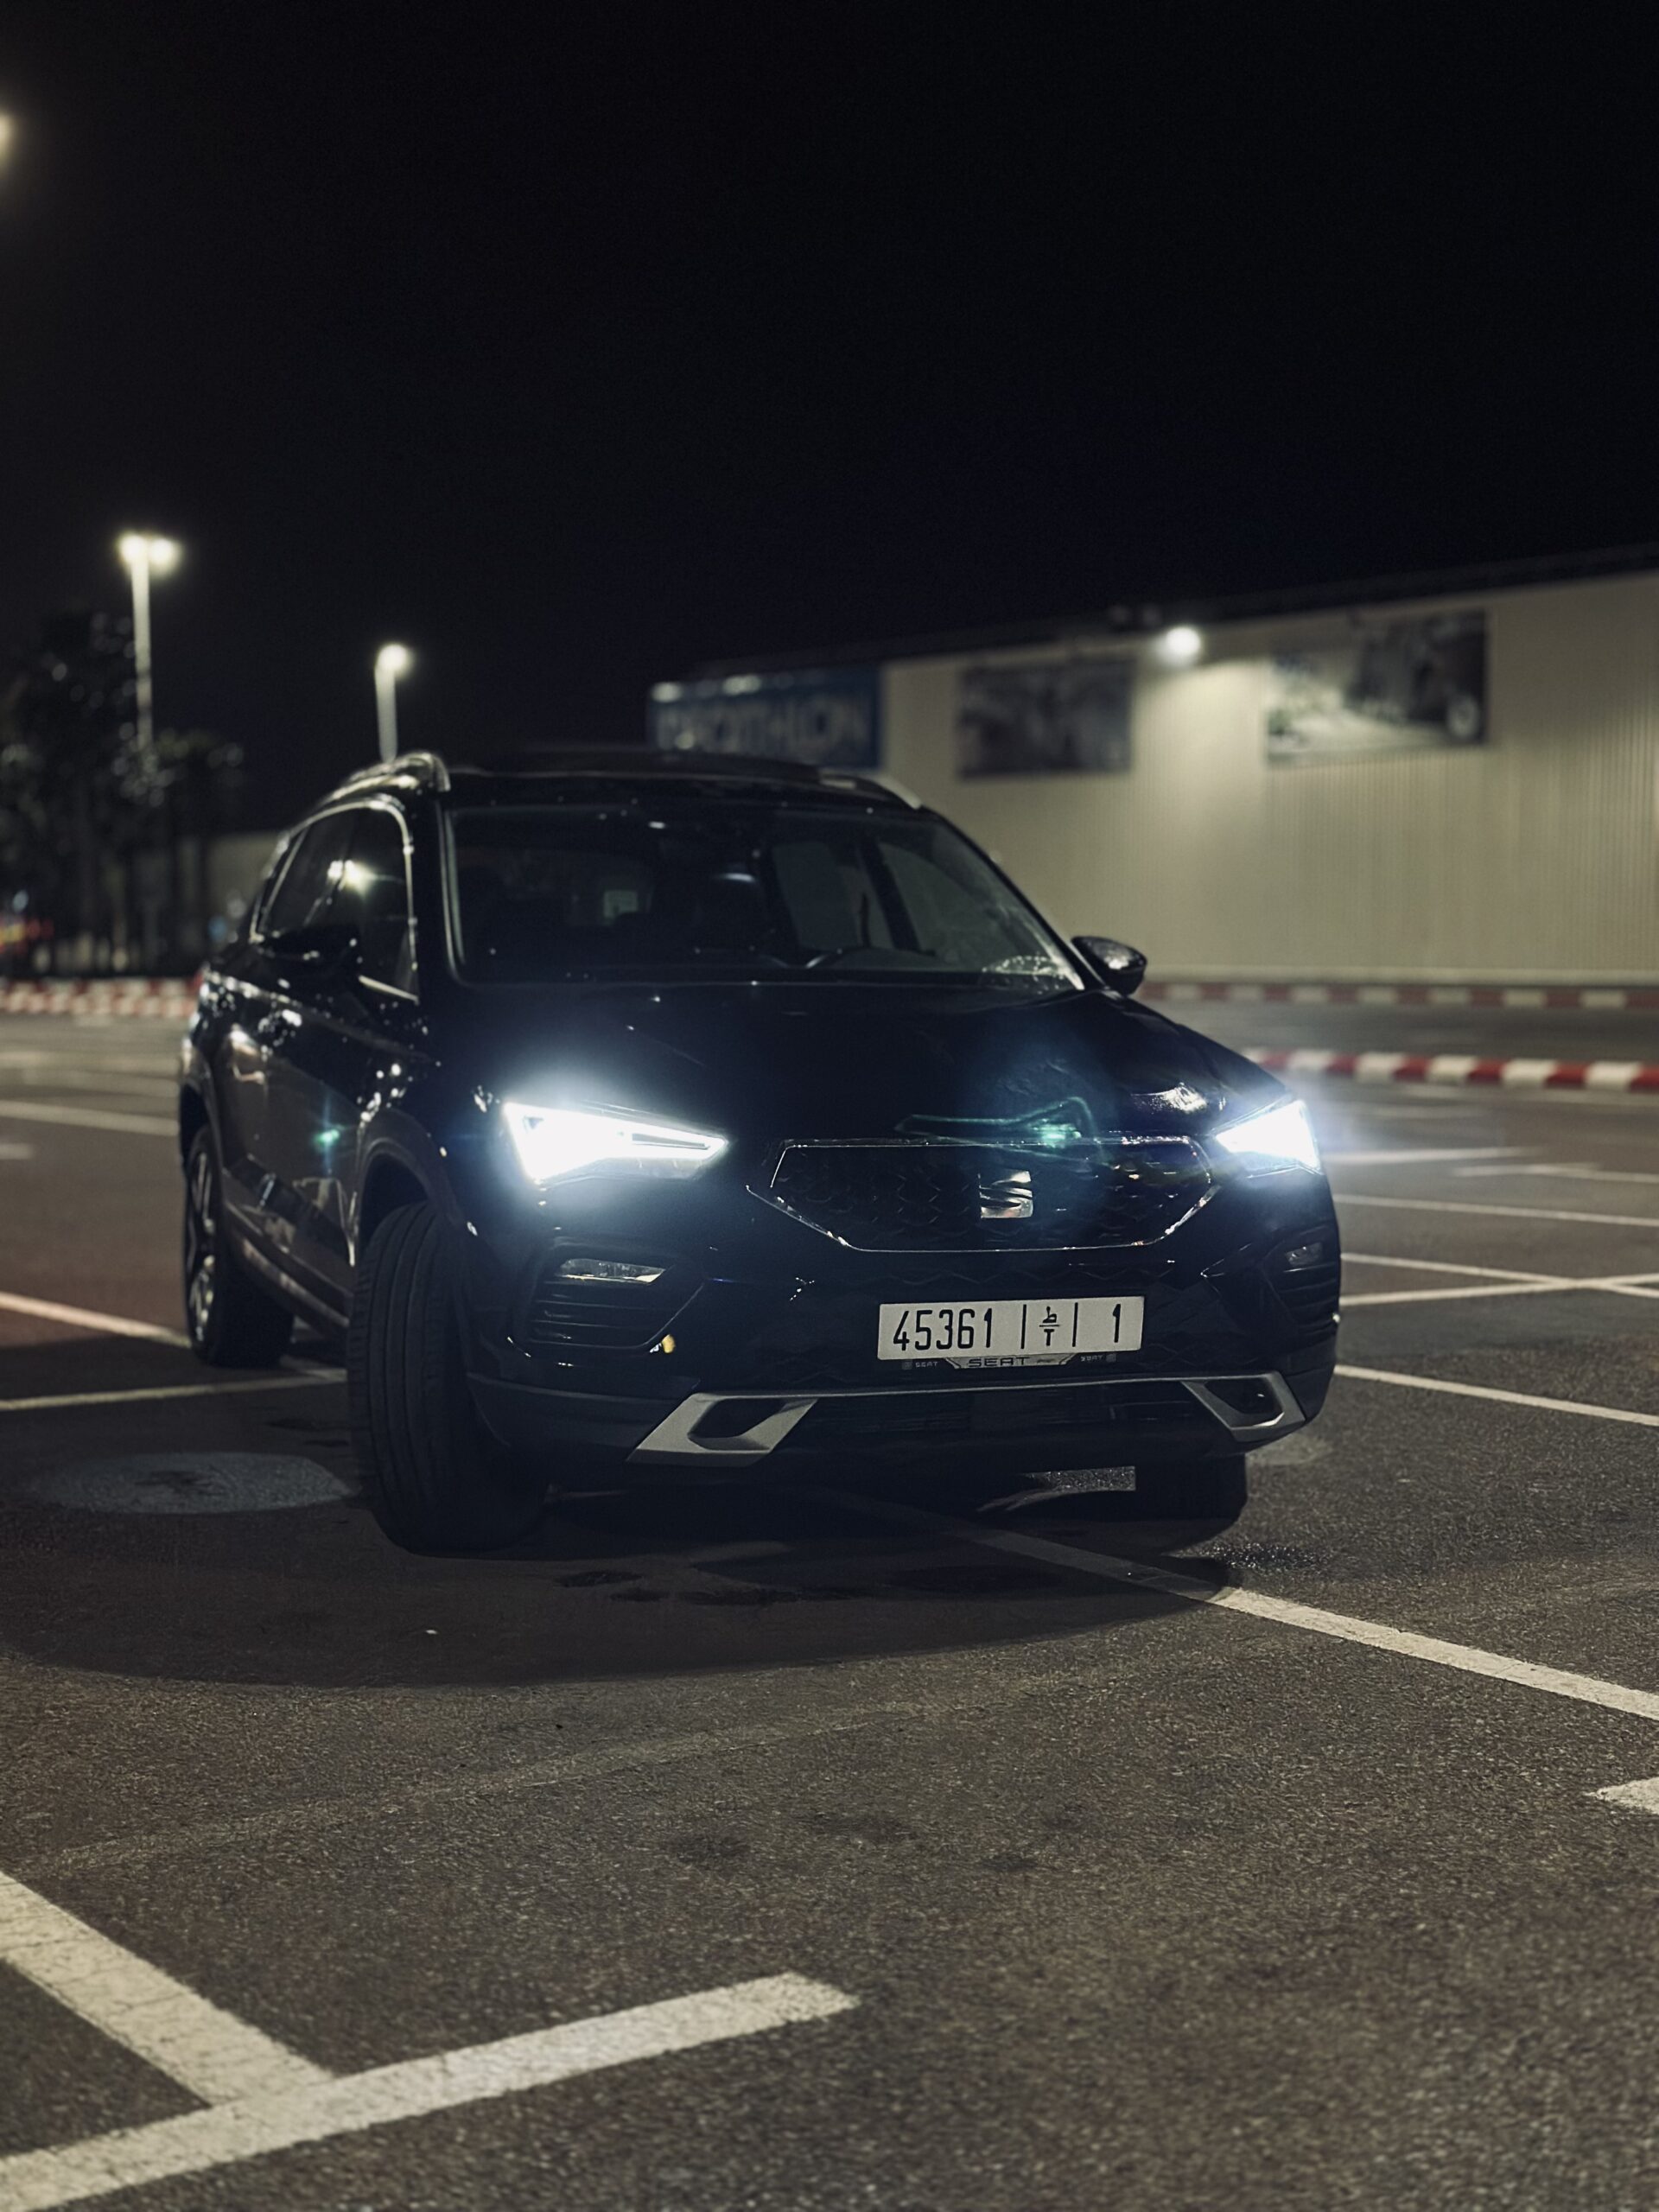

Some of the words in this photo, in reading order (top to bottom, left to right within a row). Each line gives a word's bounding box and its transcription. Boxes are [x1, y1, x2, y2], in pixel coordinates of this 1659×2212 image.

[657, 695, 872, 765] CATHLON
[893, 1308, 992, 1351] 45361
[1112, 1303, 1121, 1344] 1
[968, 1357, 1030, 1368] SEAT
